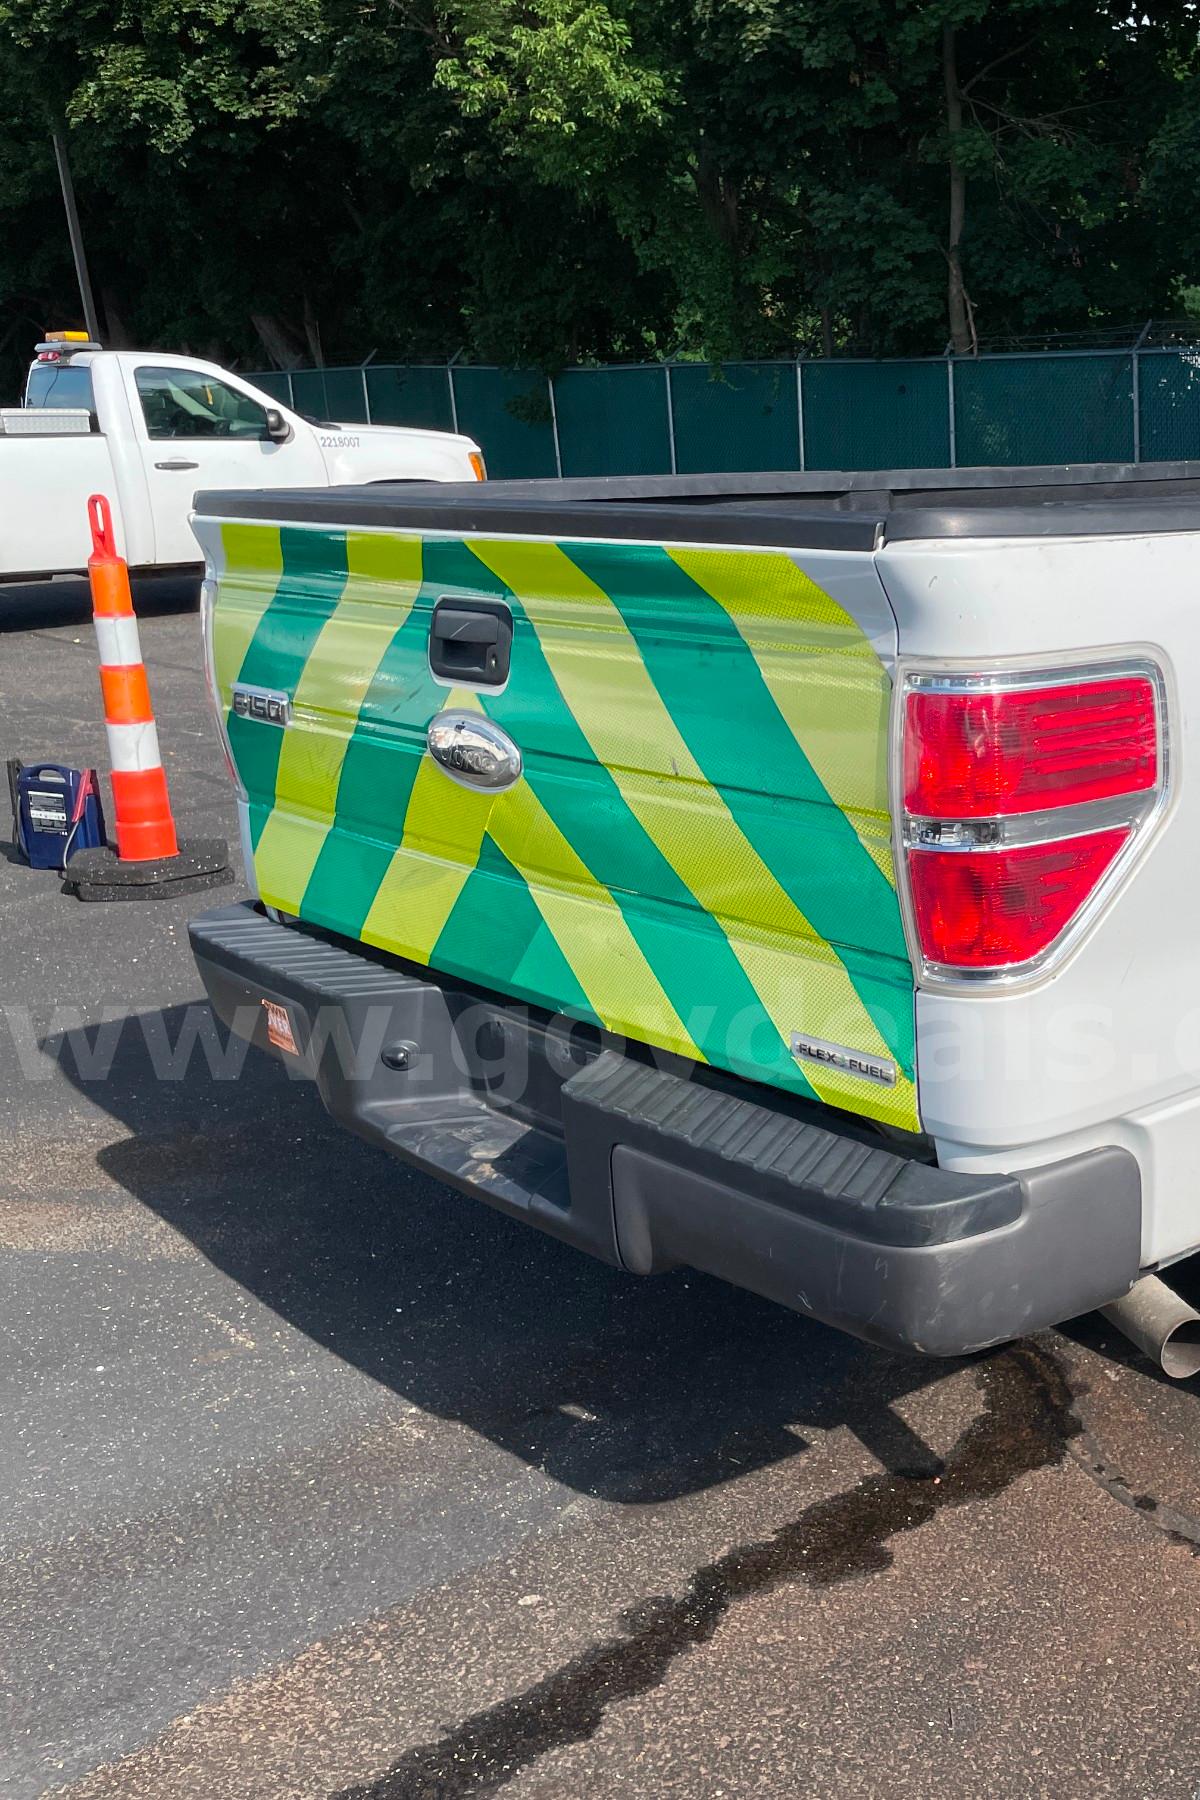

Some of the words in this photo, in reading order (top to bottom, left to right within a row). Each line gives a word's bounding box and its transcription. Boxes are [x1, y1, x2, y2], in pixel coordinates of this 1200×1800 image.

[321, 436, 360, 448] 2218007
[799, 1043, 837, 1064] FLEX
[849, 1059, 892, 1081] FUEL
